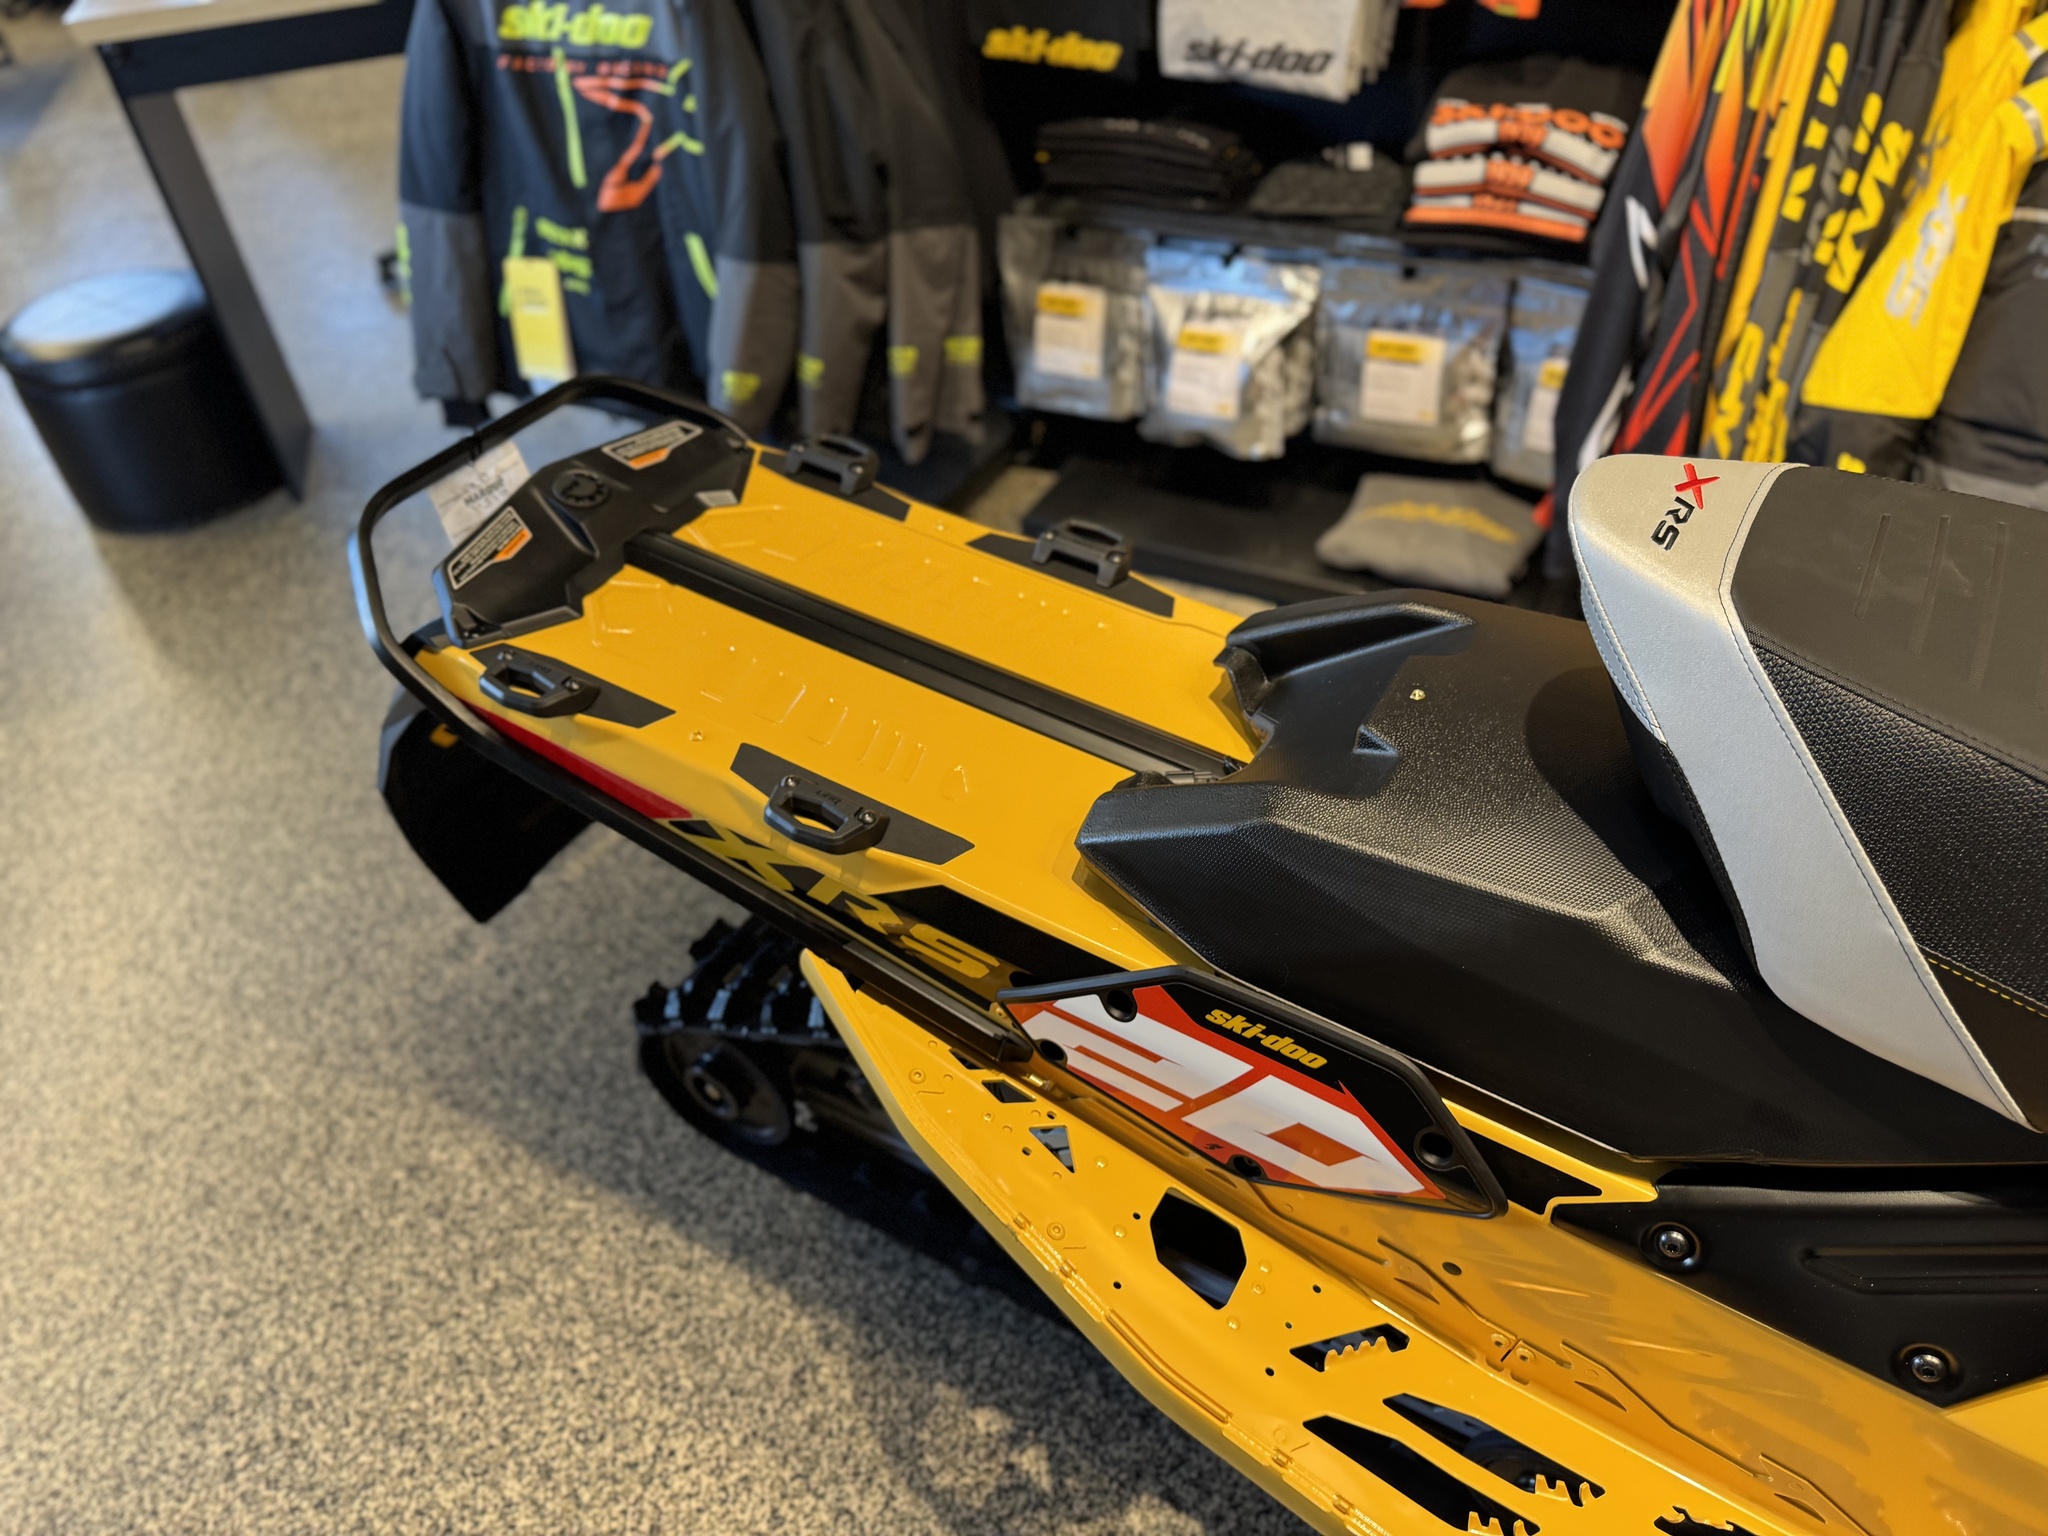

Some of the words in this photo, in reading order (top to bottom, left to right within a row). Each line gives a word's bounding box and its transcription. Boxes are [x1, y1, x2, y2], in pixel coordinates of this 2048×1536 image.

[499, 2, 652, 48] ski-doo
[983, 26, 1124, 71] ski-doo
[1183, 35, 1336, 76] ski-doo
[1651, 463, 1720, 551] XRS
[1205, 1007, 1327, 1070] ski-doo
